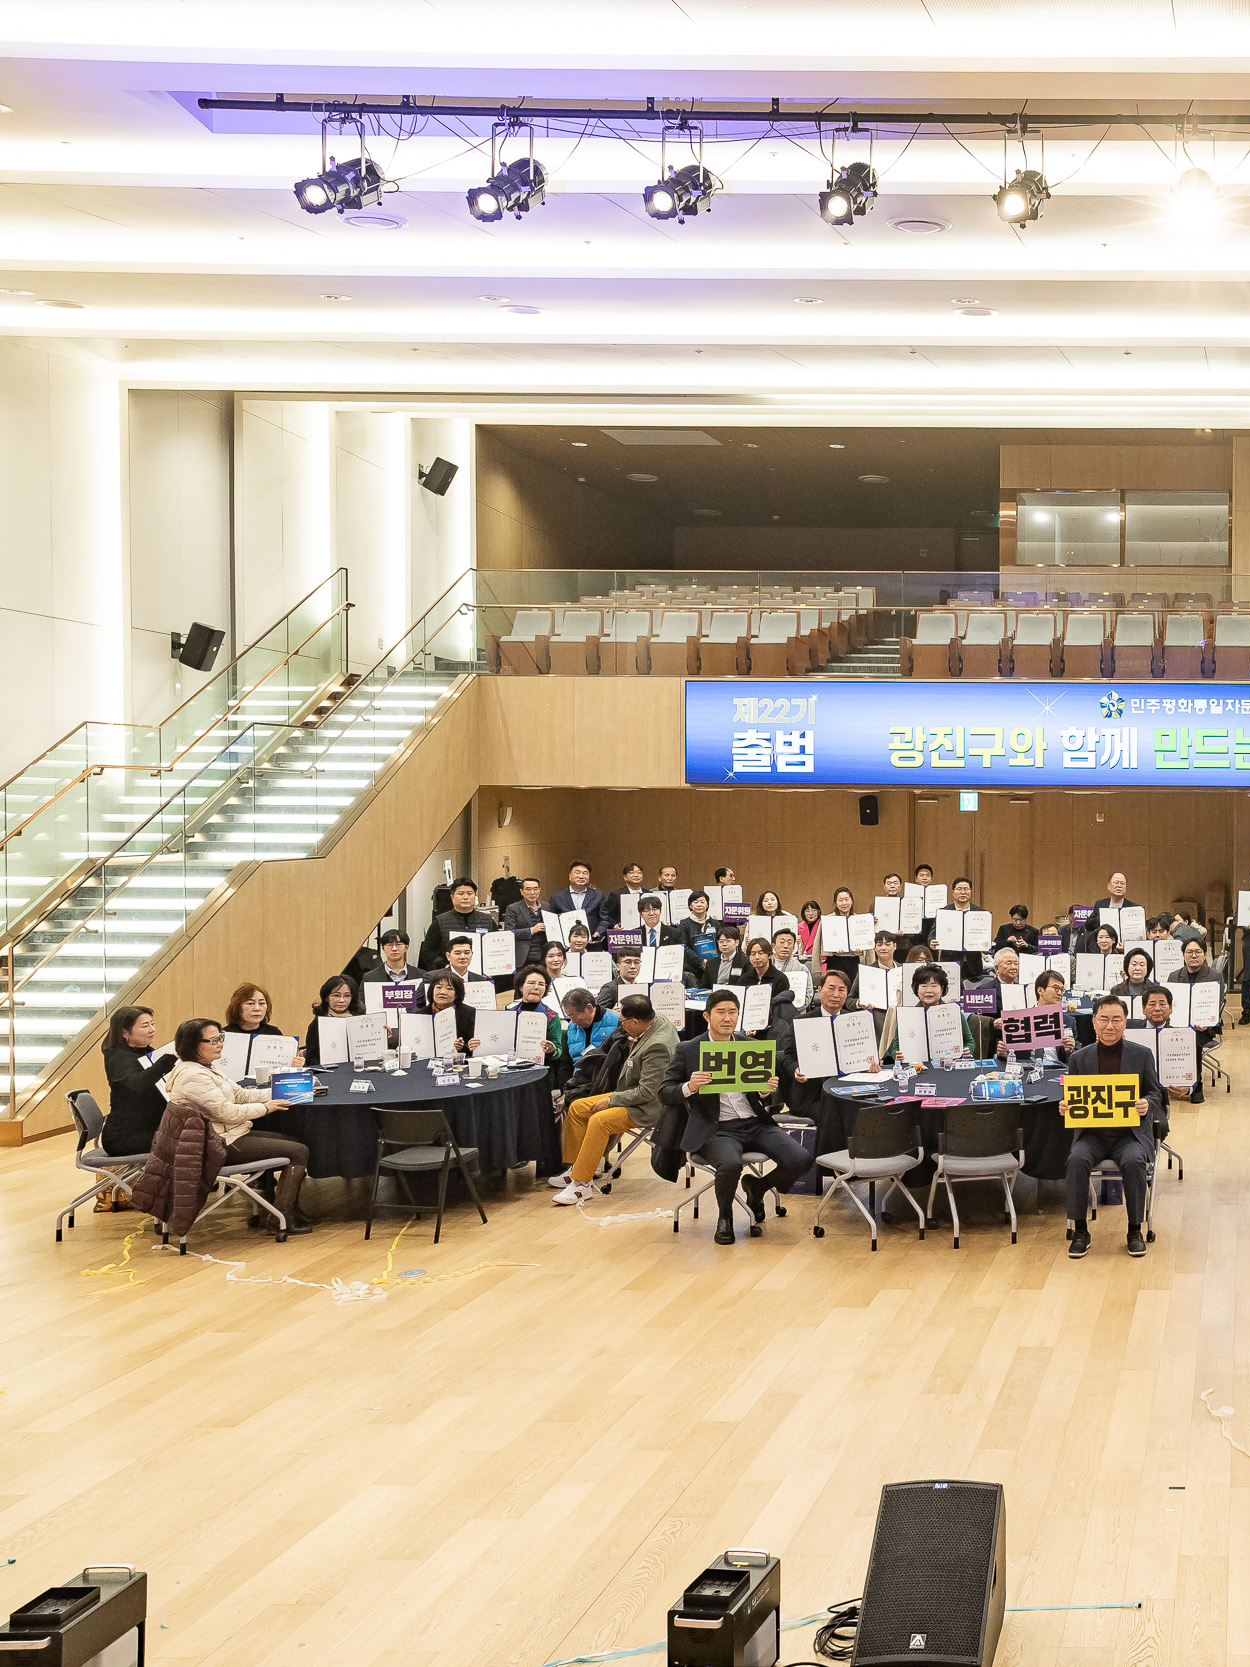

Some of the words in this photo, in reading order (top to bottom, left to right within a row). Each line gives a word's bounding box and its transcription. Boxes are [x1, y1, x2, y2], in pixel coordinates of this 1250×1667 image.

[732, 696, 816, 725] 제22기
[731, 729, 815, 773] 출범
[887, 726, 1048, 770] 광진구와
[1060, 726, 1139, 770] 함께
[725, 906, 751, 915] 자문위원
[609, 934, 642, 945] 자문위원
[384, 989, 414, 999] 부회장
[965, 994, 994, 1004] 내빈석
[1003, 1011, 1062, 1044] 협력
[702, 1050, 772, 1085] 번영
[1067, 1084, 1136, 1120] 광진구
